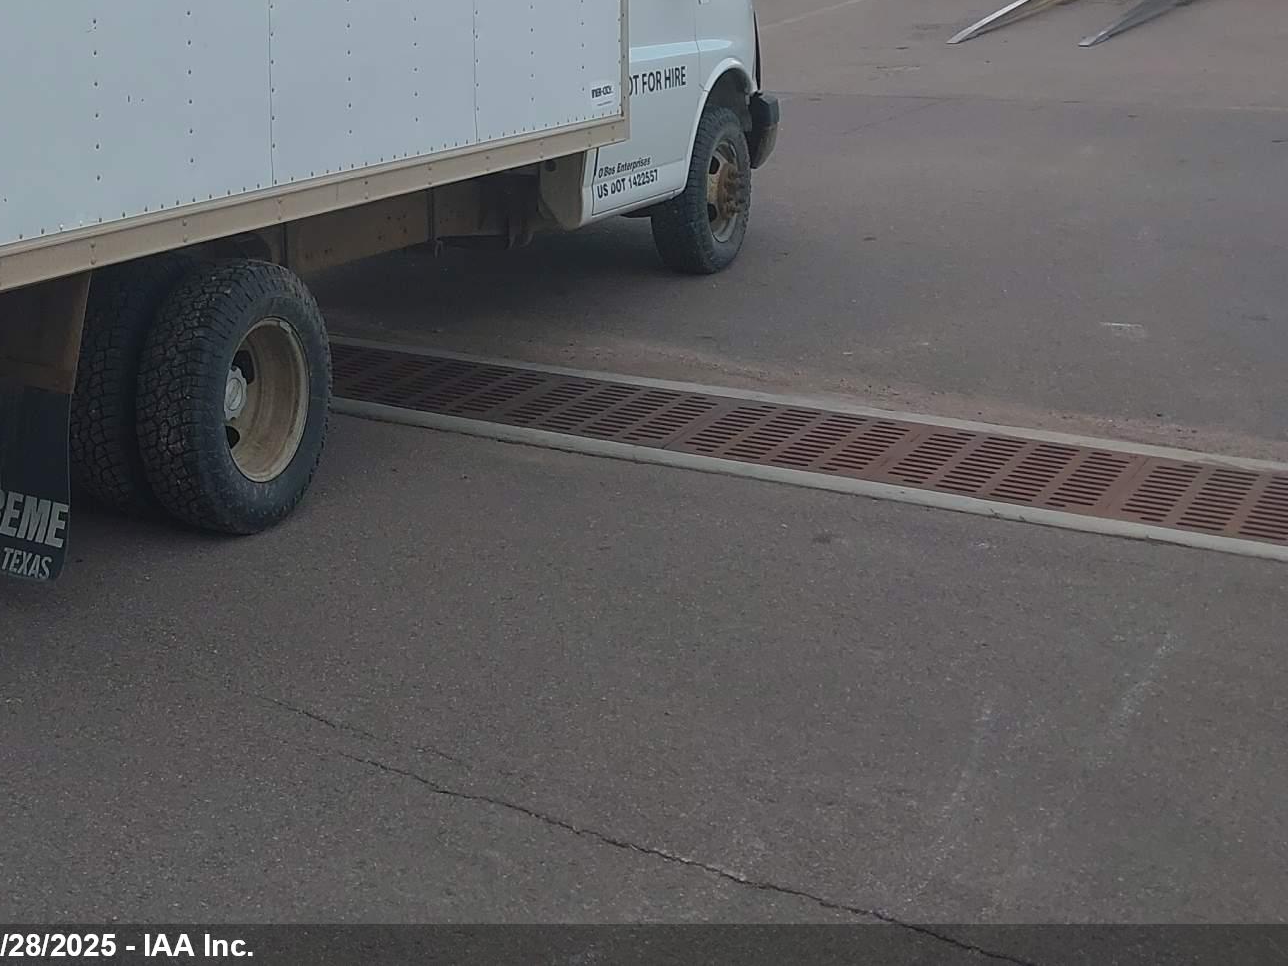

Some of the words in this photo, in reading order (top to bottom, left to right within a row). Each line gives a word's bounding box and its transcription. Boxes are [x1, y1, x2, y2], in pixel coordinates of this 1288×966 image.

[642, 71, 662, 94] FOR
[664, 66, 687, 89] HIRE
[617, 157, 651, 173] Enterprises
[597, 183, 609, 198] US
[611, 178, 626, 194] DOT
[2, 547, 52, 579] TEXAS
